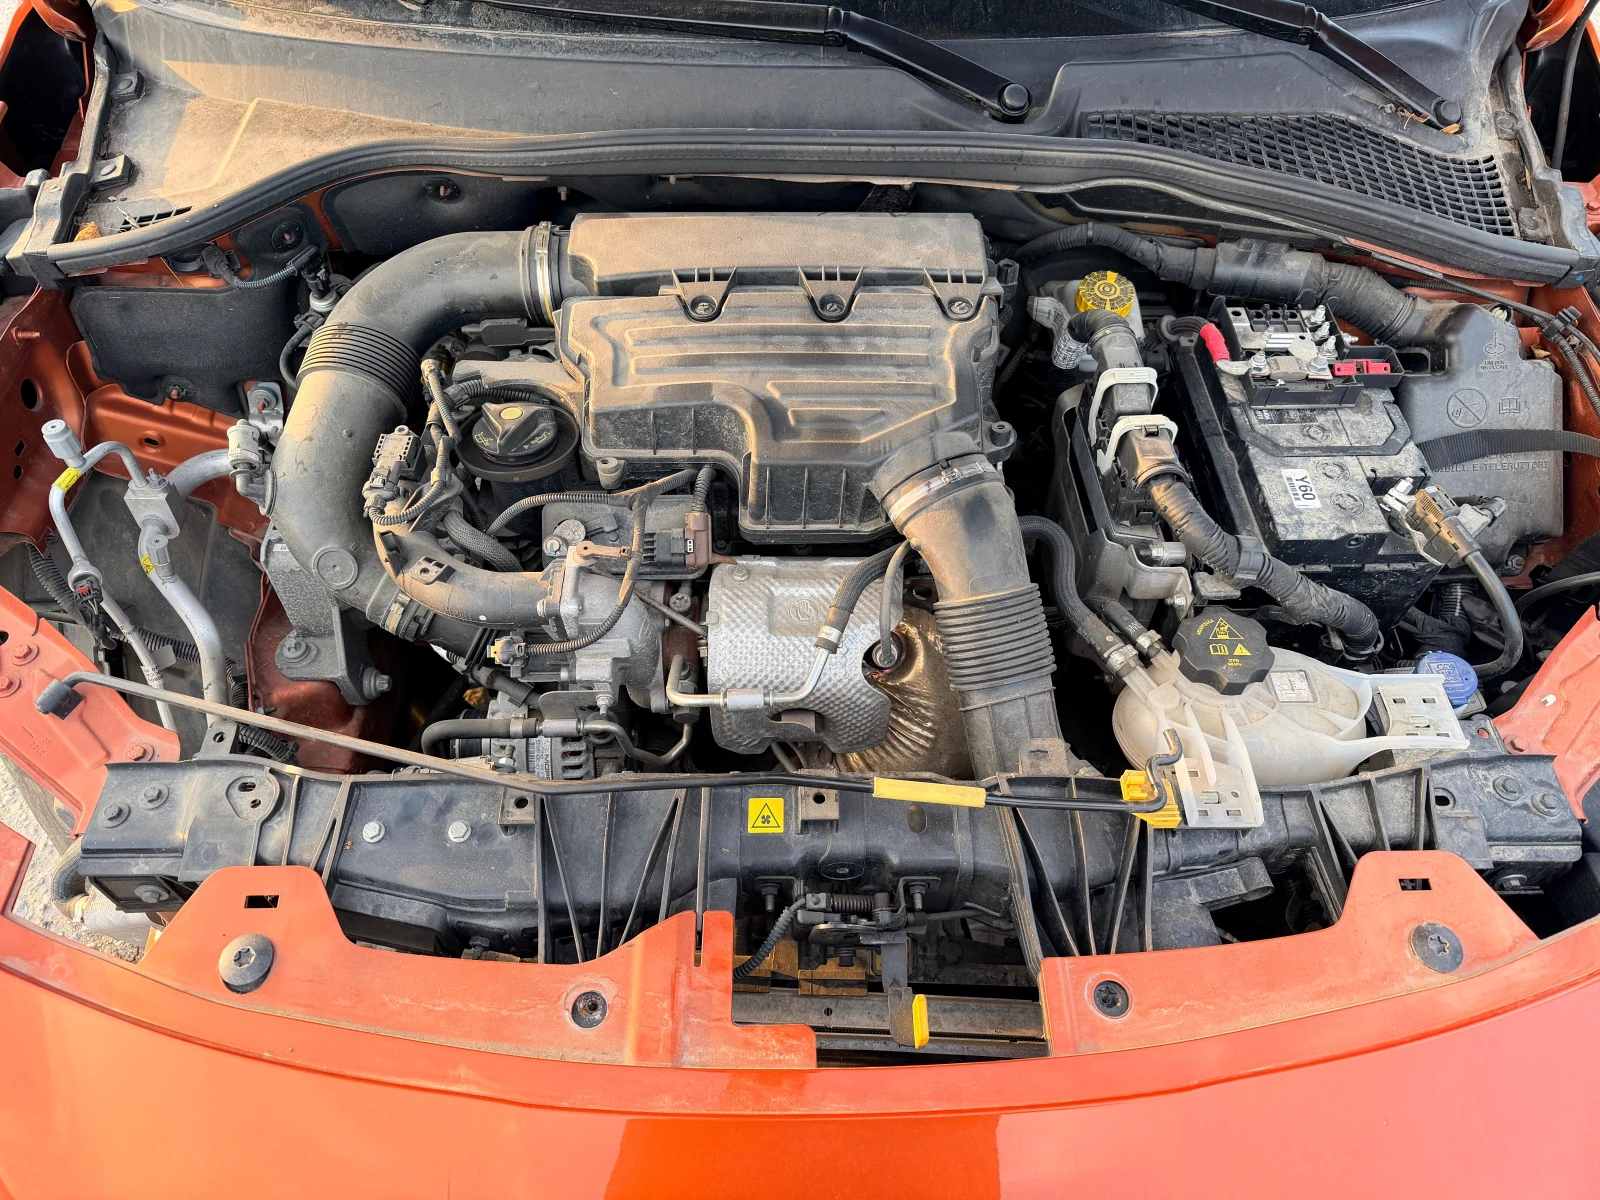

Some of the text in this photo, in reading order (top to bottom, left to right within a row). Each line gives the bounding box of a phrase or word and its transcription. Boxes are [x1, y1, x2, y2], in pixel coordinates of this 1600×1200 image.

[1472, 463, 1478, 471] E
[1483, 460, 1548, 471] TELERUTTORI
[1295, 475, 1316, 501] Y60
